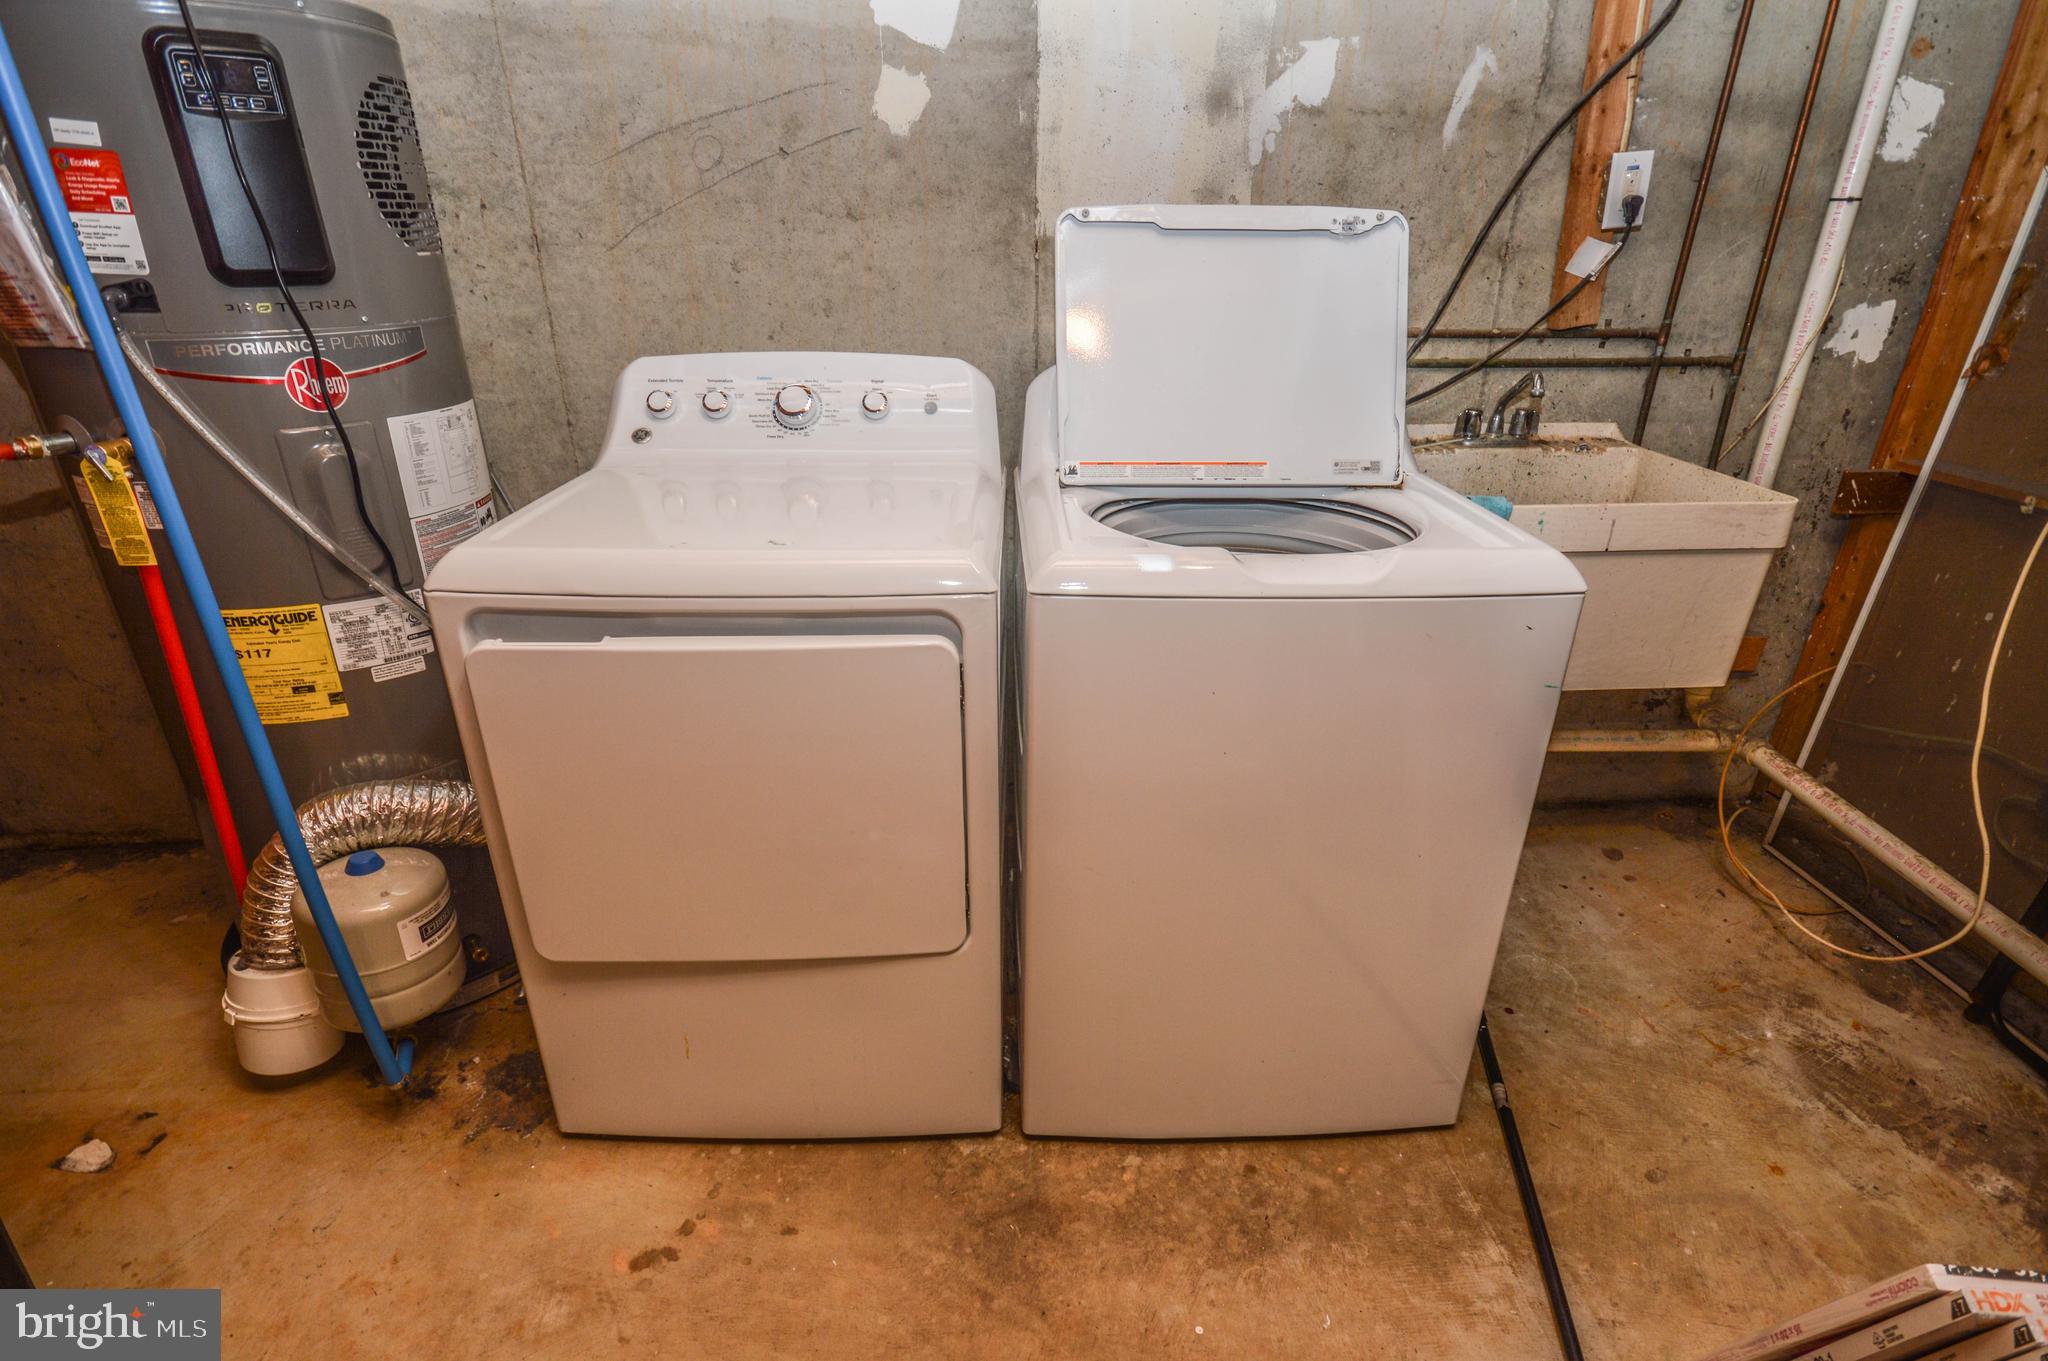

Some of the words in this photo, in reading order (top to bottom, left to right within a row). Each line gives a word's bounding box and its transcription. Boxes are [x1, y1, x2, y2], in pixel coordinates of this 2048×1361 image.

[69, 157, 100, 168] EcoNet
[175, 337, 326, 358] PERFORMANCE
[289, 357, 346, 403] Rhem
[1970, 1288, 2033, 1314] HDX
